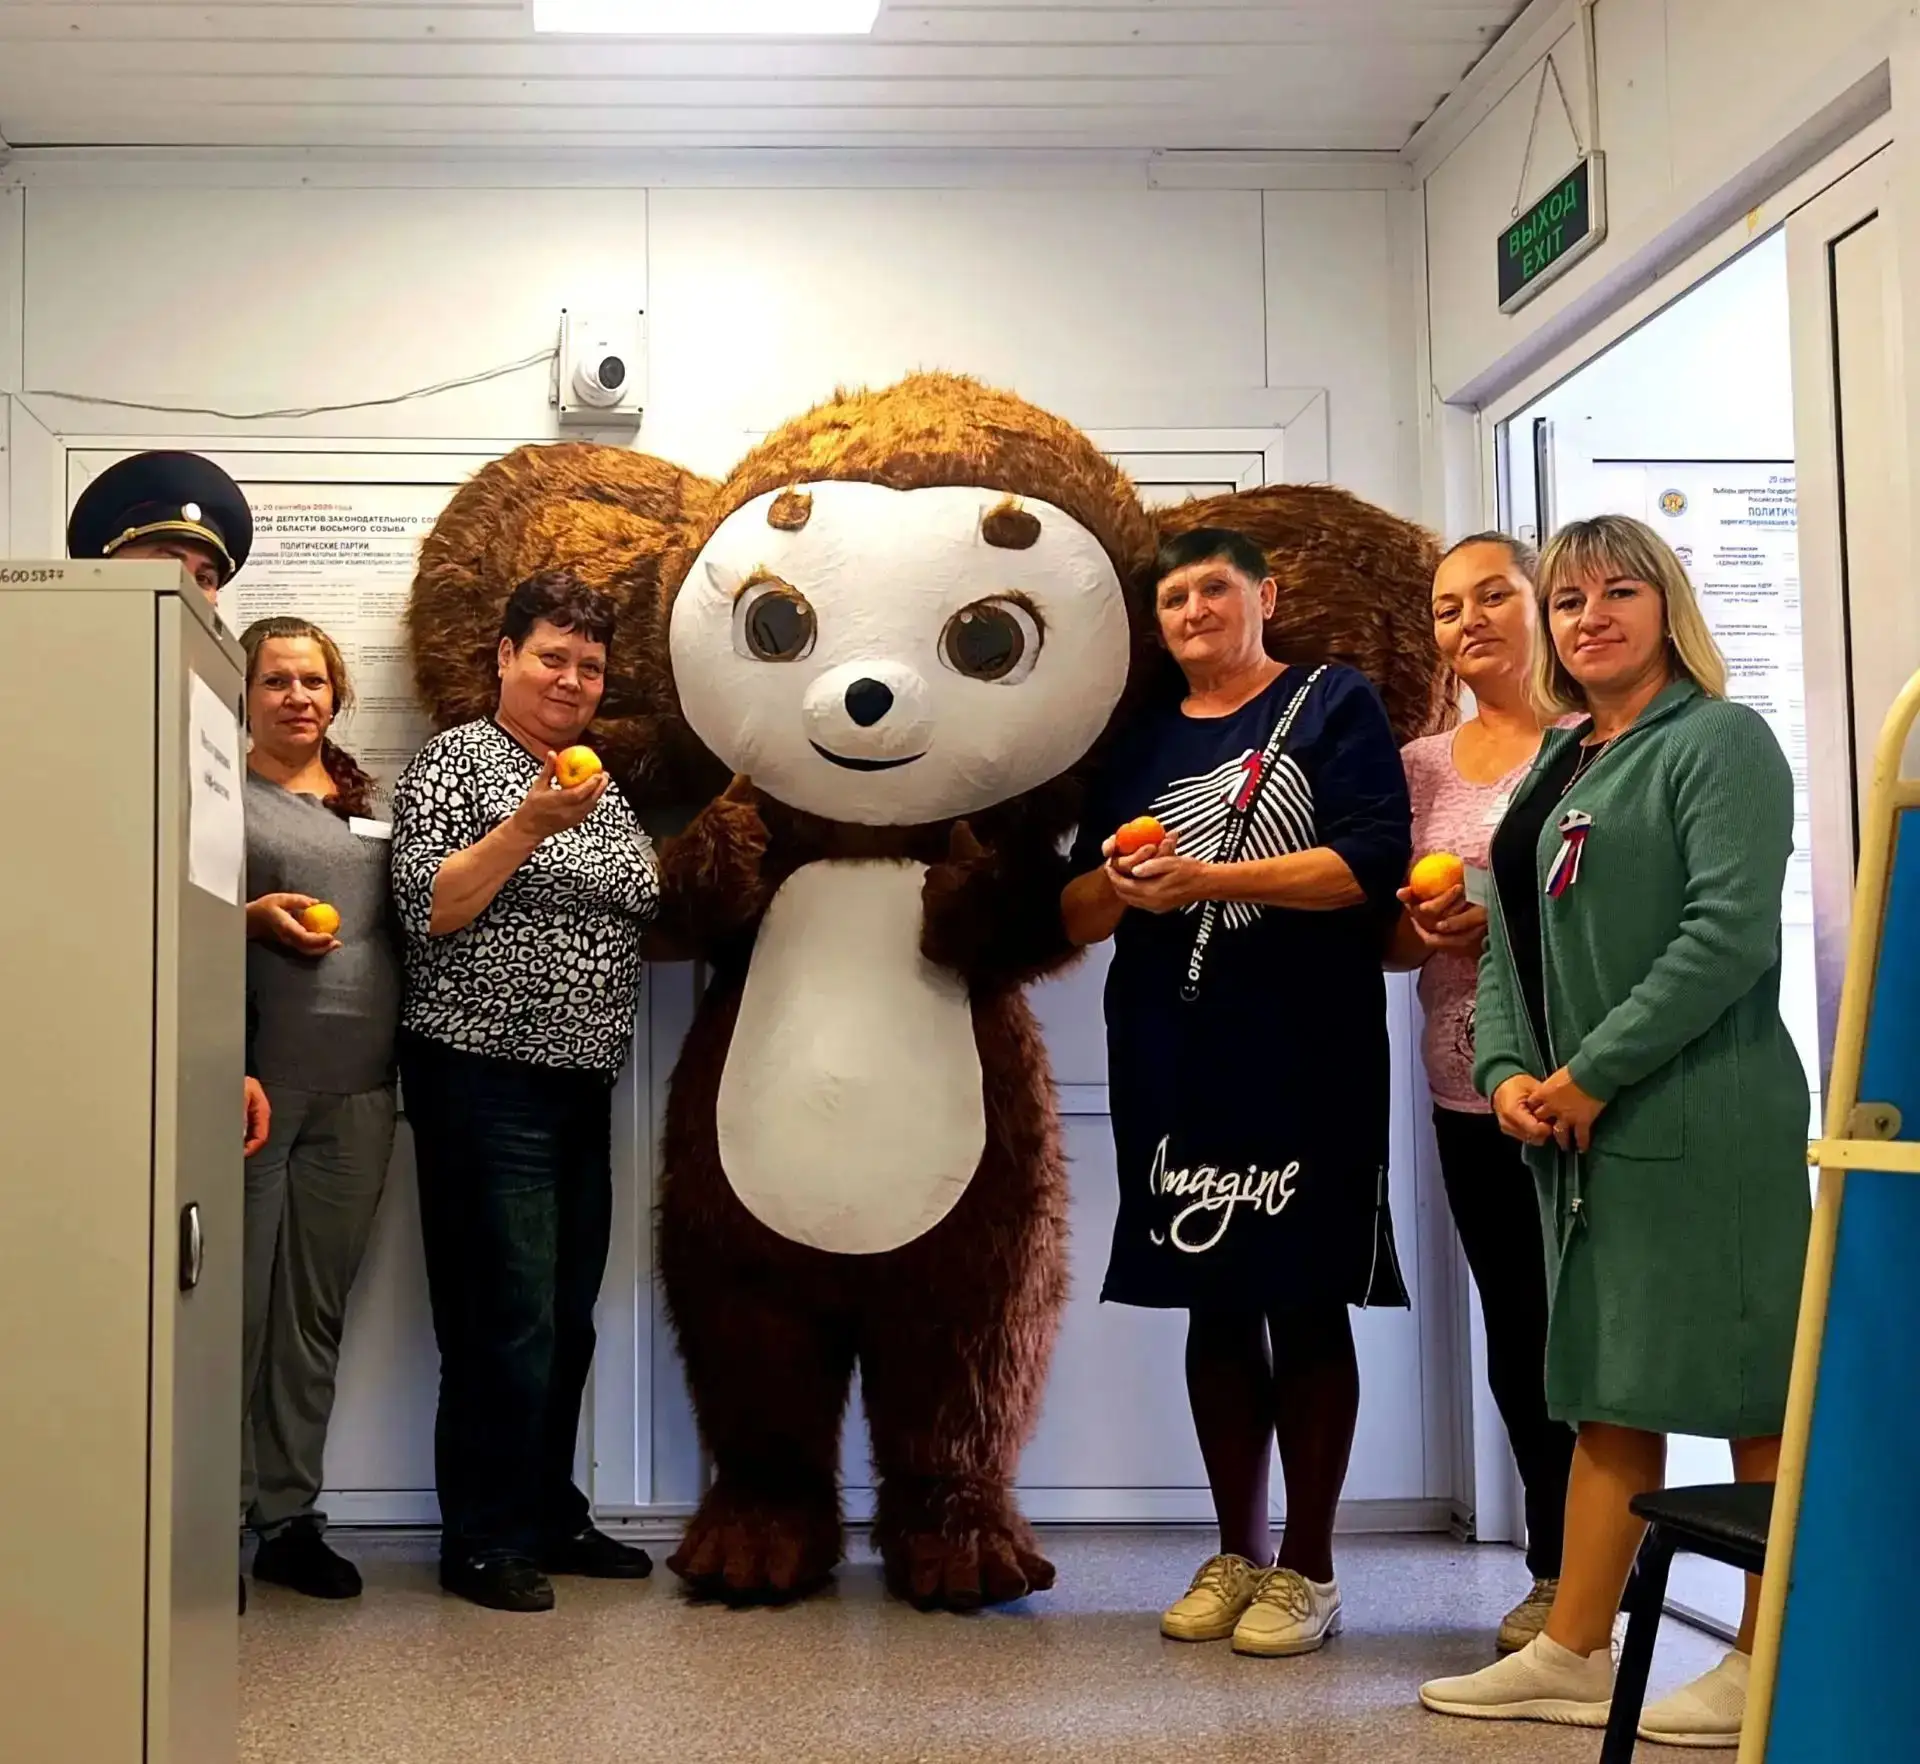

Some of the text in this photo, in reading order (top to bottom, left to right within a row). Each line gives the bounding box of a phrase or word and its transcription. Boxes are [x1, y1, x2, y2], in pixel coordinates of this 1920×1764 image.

[1508, 180, 1578, 258] ВЫХОД
[1522, 224, 1564, 280] EXIT
[276, 515, 326, 523] ДЕПУТАТОВ
[328, 515, 418, 524] ЗАКОНОДАТЕЛЬНОГО
[1748, 507, 1797, 517] ПОЛИТИЧ
[370, 525, 406, 533] СОЗЫВА
[280, 542, 369, 550] ПОЛИТИЧЕСКИЕ ПАРТИИ
[1187, 900, 1219, 981] OFF-WHIT
[1150, 1134, 1300, 1252] Imagine
